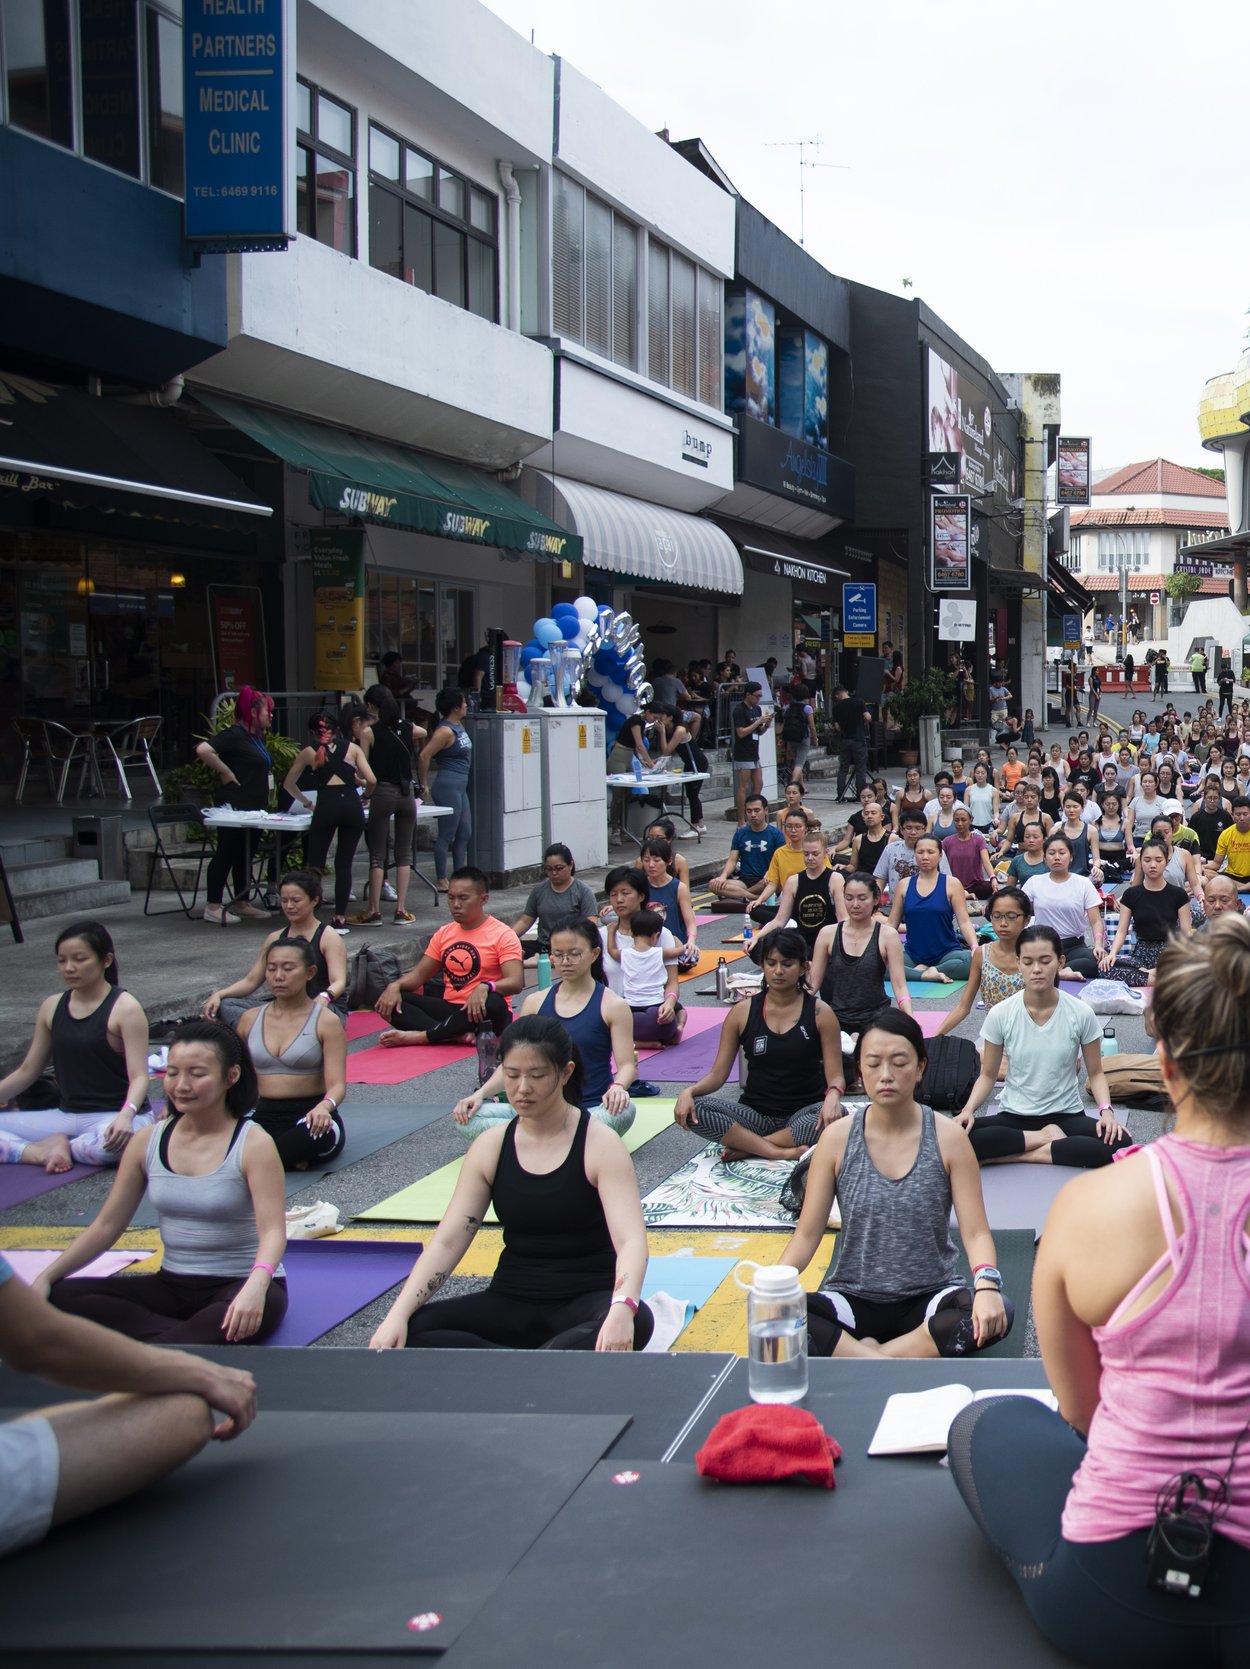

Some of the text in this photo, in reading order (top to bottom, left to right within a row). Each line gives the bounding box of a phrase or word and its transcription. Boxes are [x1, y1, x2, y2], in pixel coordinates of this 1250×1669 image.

[192, 33, 276, 57] PARTNERS
[200, 88, 270, 112] MEDICAL
[209, 129, 261, 155] CLINIC
[251, 185, 278, 196] 9116
[684, 428, 714, 459] bump
[21, 475, 54, 492] Bar
[338, 487, 397, 518] SUBWAY
[443, 511, 491, 538] SUBWAY
[527, 531, 567, 556] SUBWAY
[783, 562, 828, 585] NAKHON KITCHEN
[1175, 565, 1212, 575] CRYSTAL JADE
